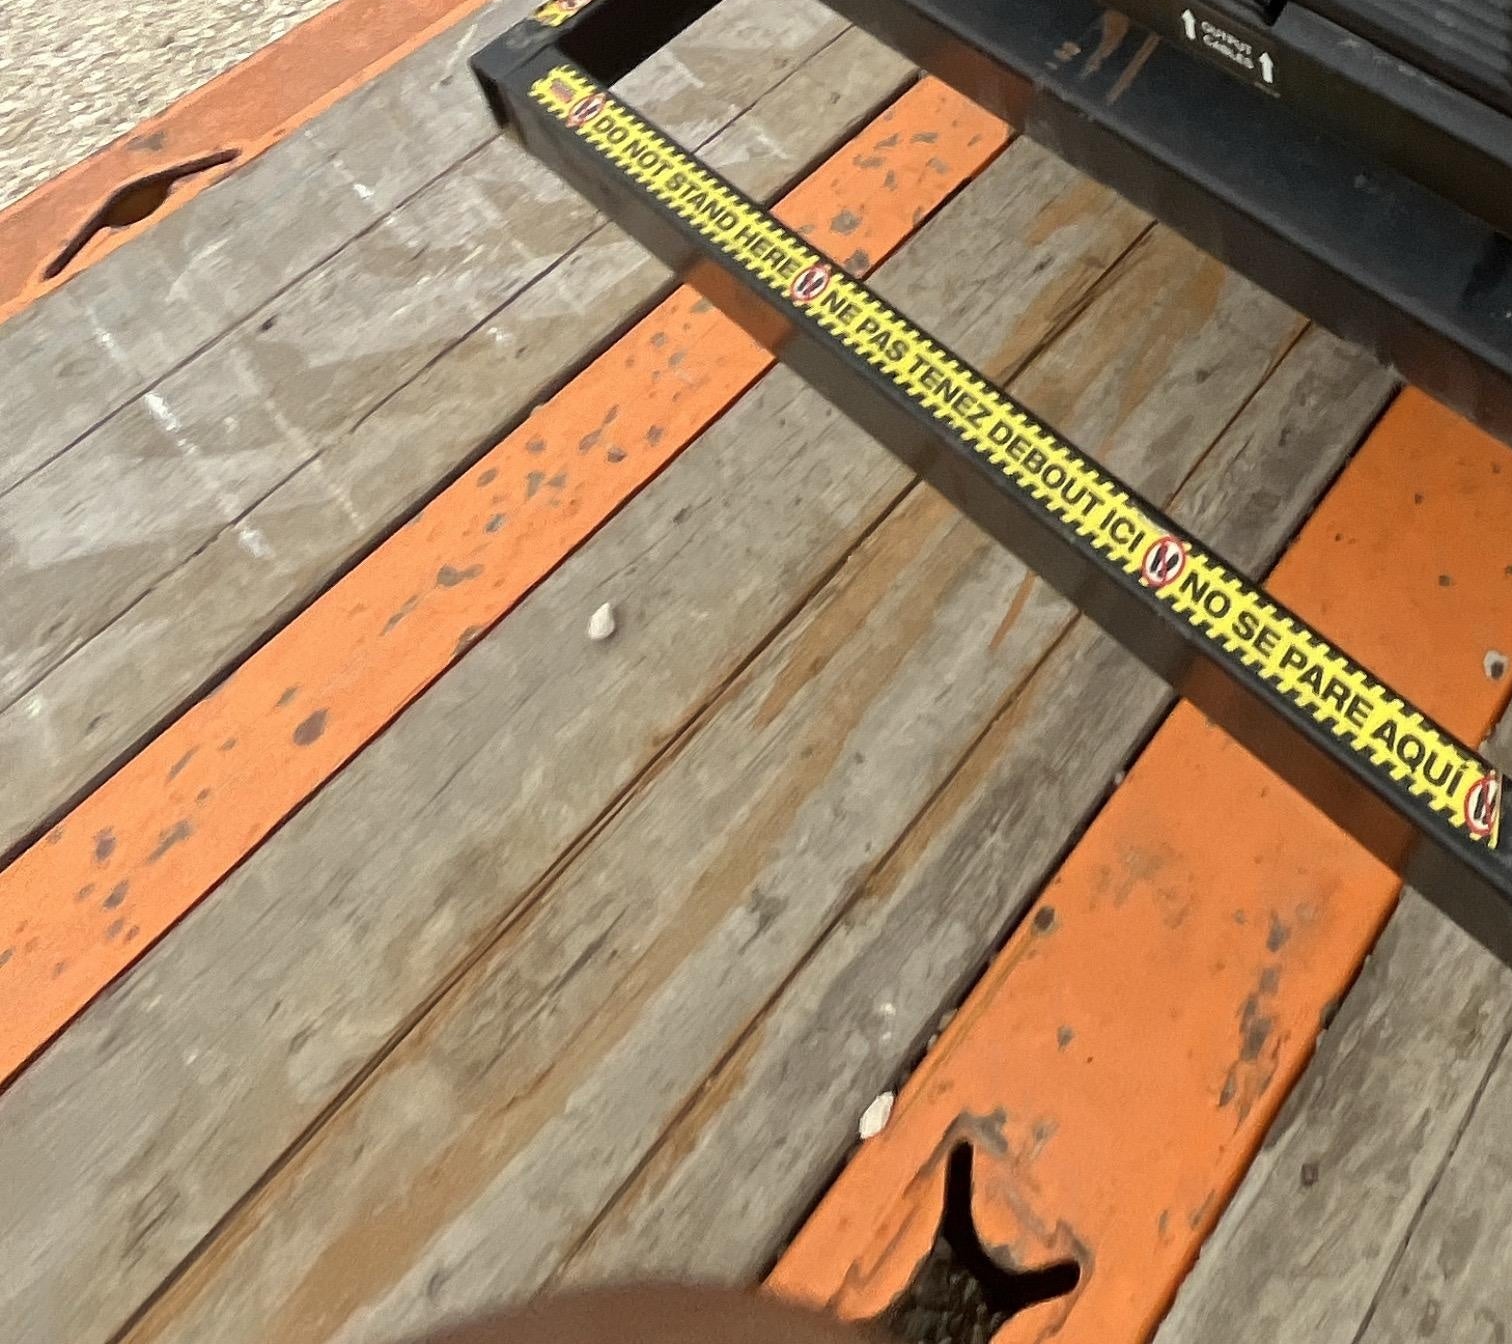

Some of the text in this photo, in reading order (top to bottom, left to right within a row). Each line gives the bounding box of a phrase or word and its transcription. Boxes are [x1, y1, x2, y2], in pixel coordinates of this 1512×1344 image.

[594, 114, 801, 281] DO NOT STAND HERE
[820, 288, 1147, 553] NE PAS TENEZ DEBOUT ICI
[1180, 571, 1470, 799] NO SE PARE AQUÍ
